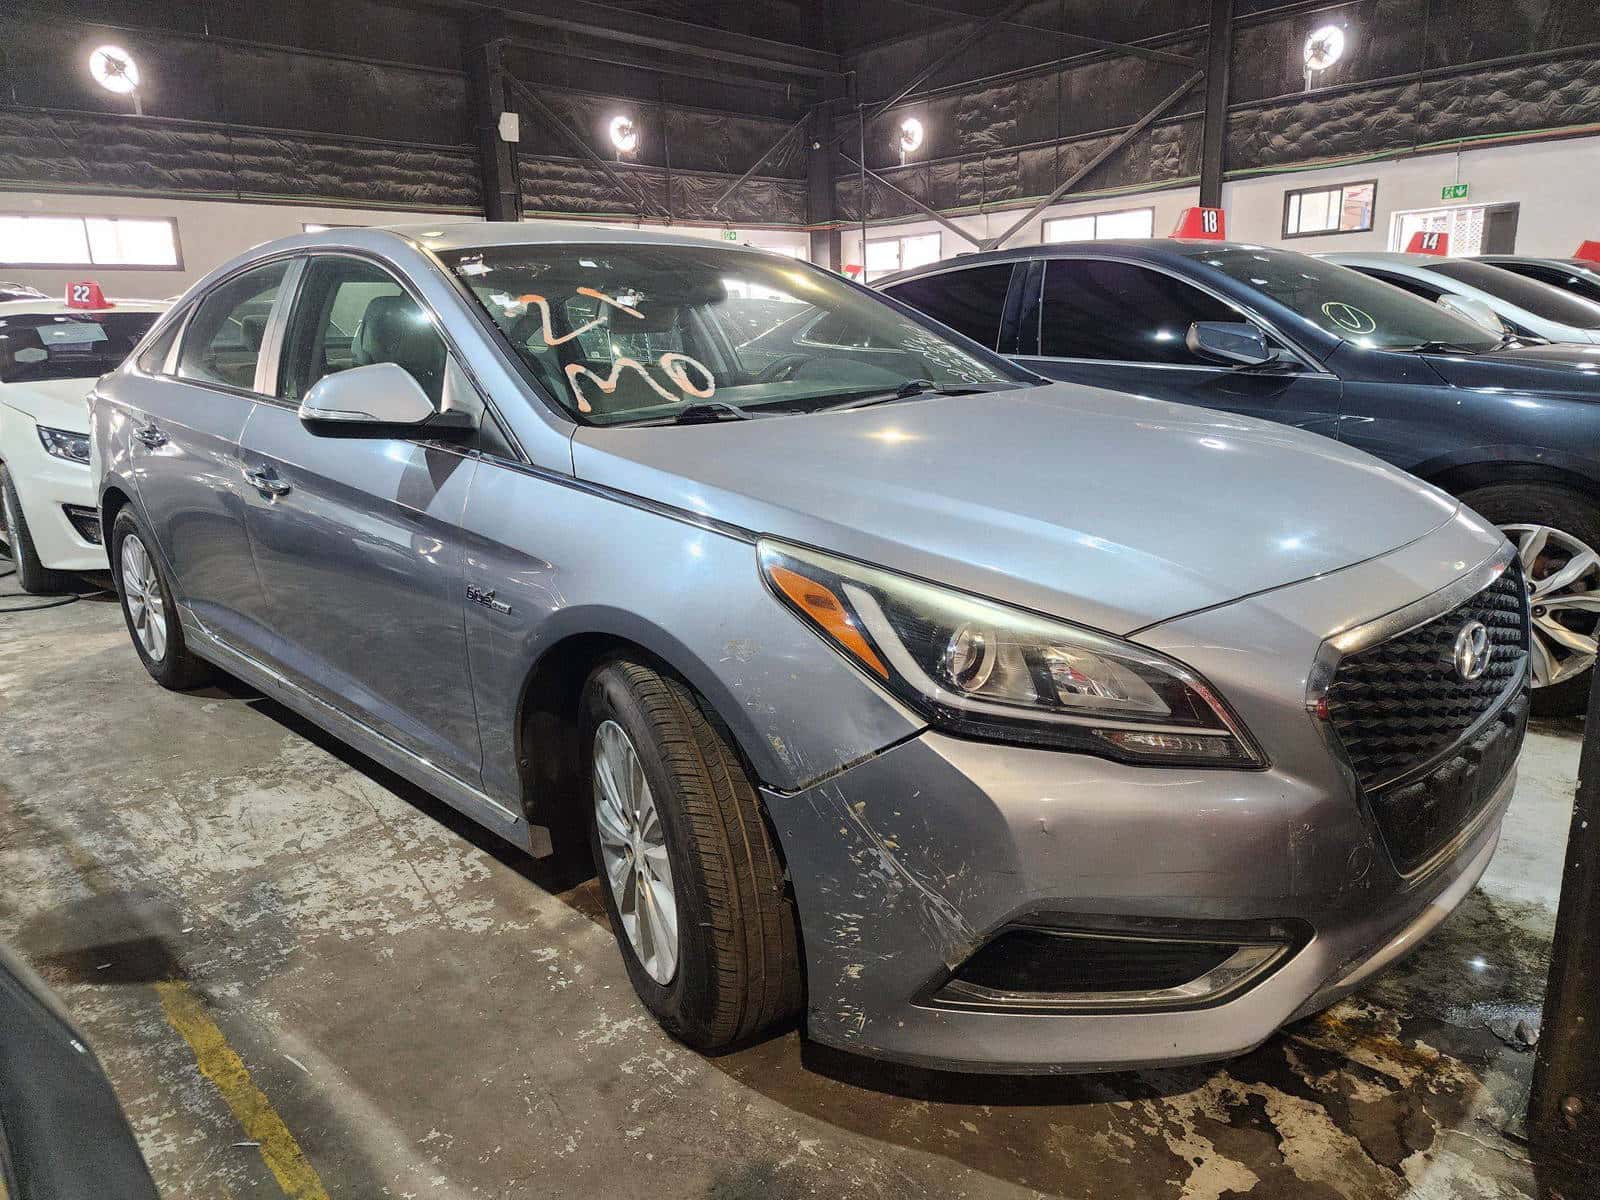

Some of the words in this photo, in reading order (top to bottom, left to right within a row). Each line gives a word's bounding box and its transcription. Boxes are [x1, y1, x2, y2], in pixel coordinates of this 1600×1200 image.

[1202, 210, 1218, 232] 18
[1422, 232, 1439, 250] 14
[73, 285, 90, 302] 22
